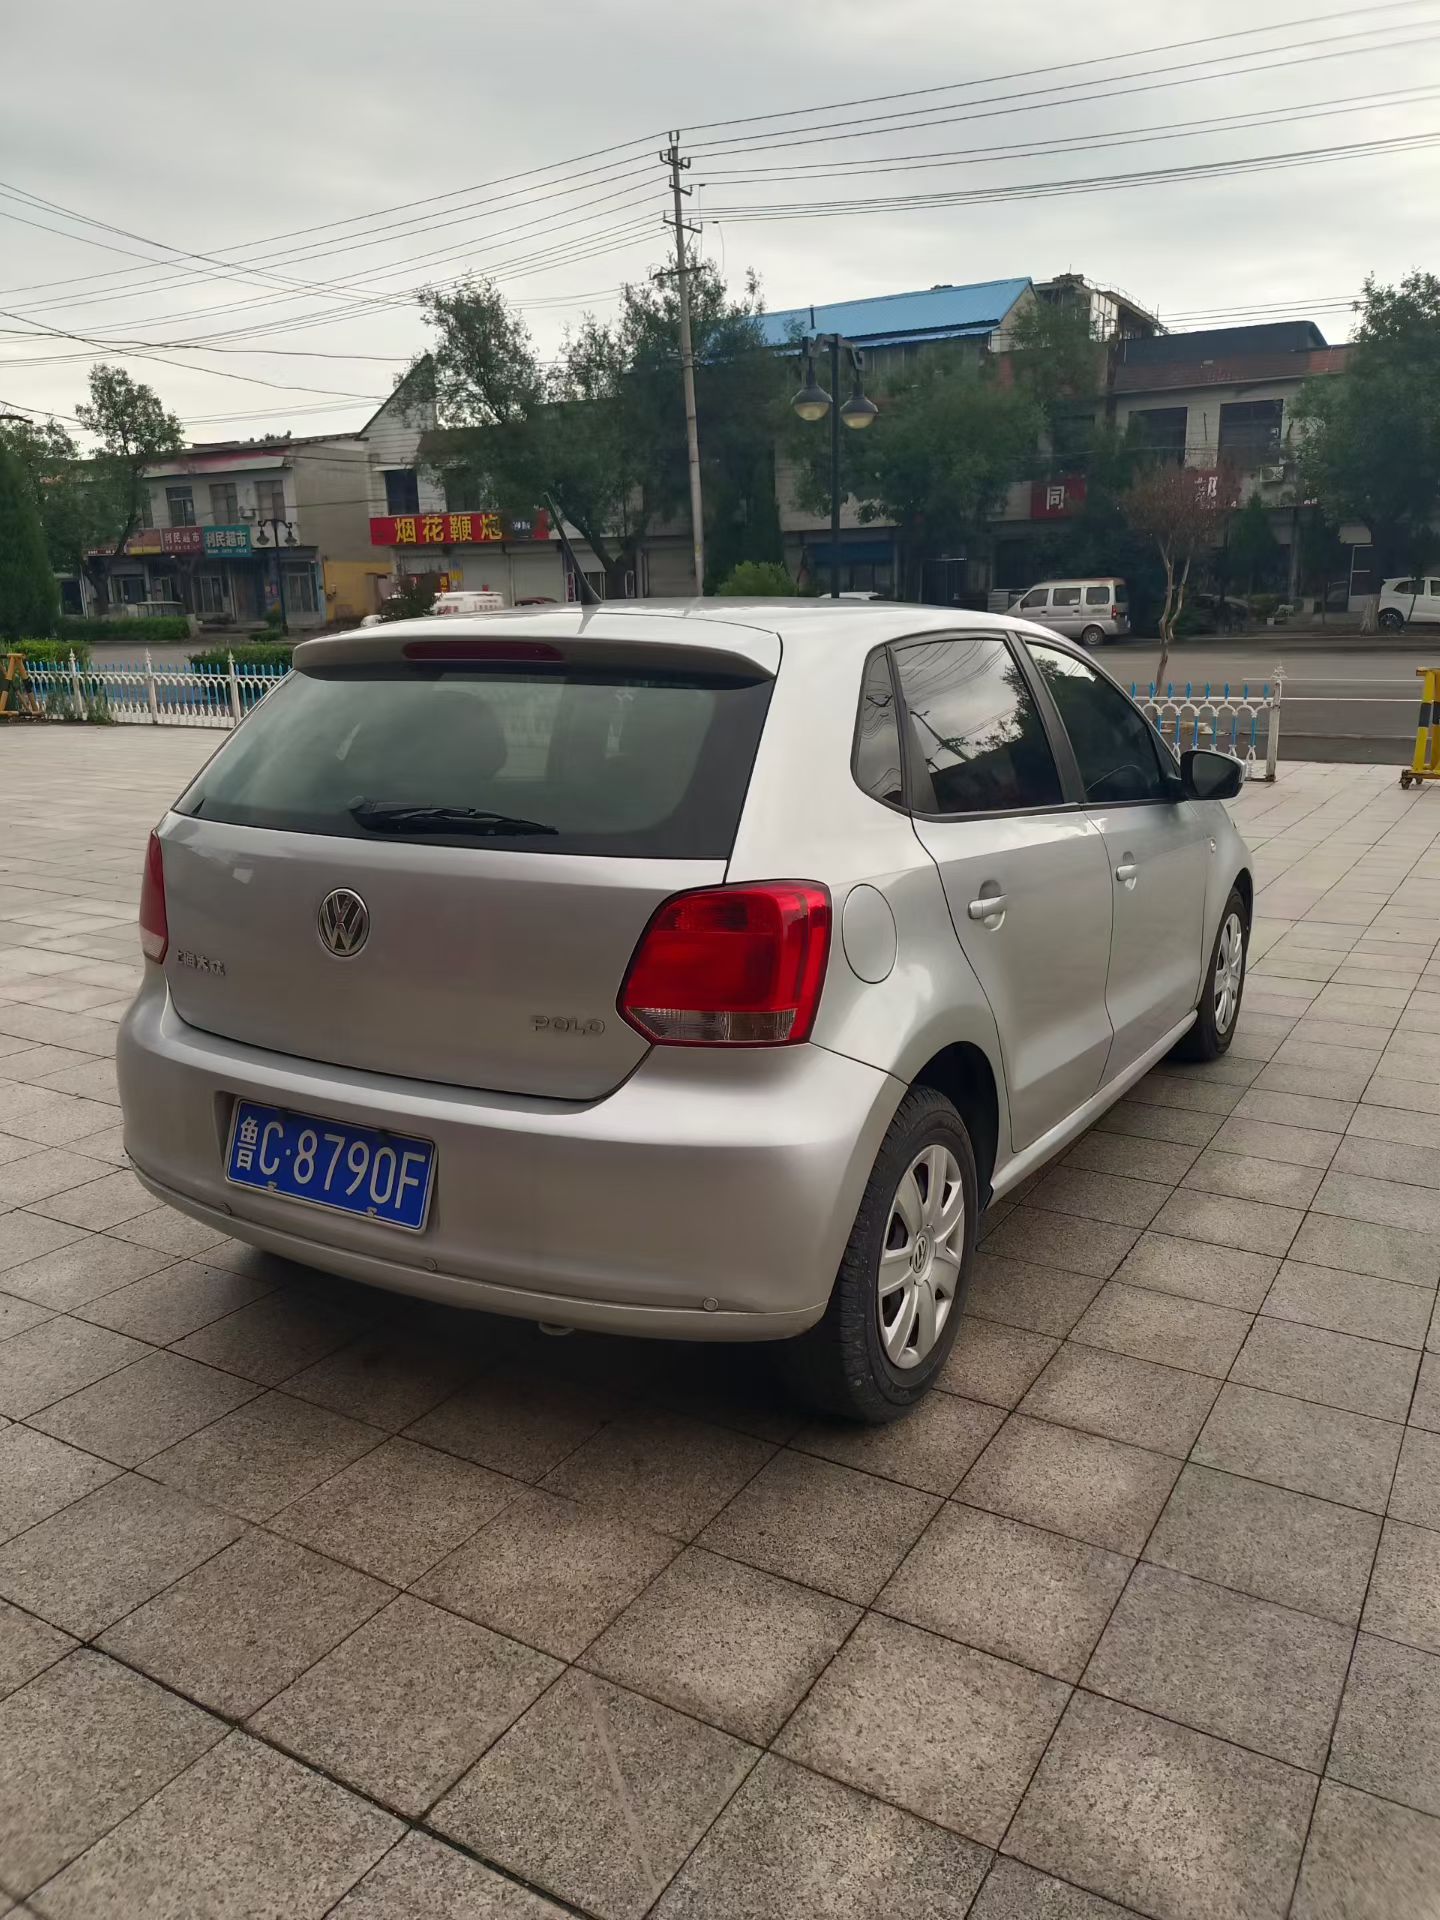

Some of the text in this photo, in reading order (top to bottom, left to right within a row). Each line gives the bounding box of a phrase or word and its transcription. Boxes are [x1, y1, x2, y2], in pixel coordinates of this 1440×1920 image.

[395, 514, 503, 543] 烟花鞭炮
[206, 531, 247, 548] 利民超市
[530, 1015, 606, 1036] POLO
